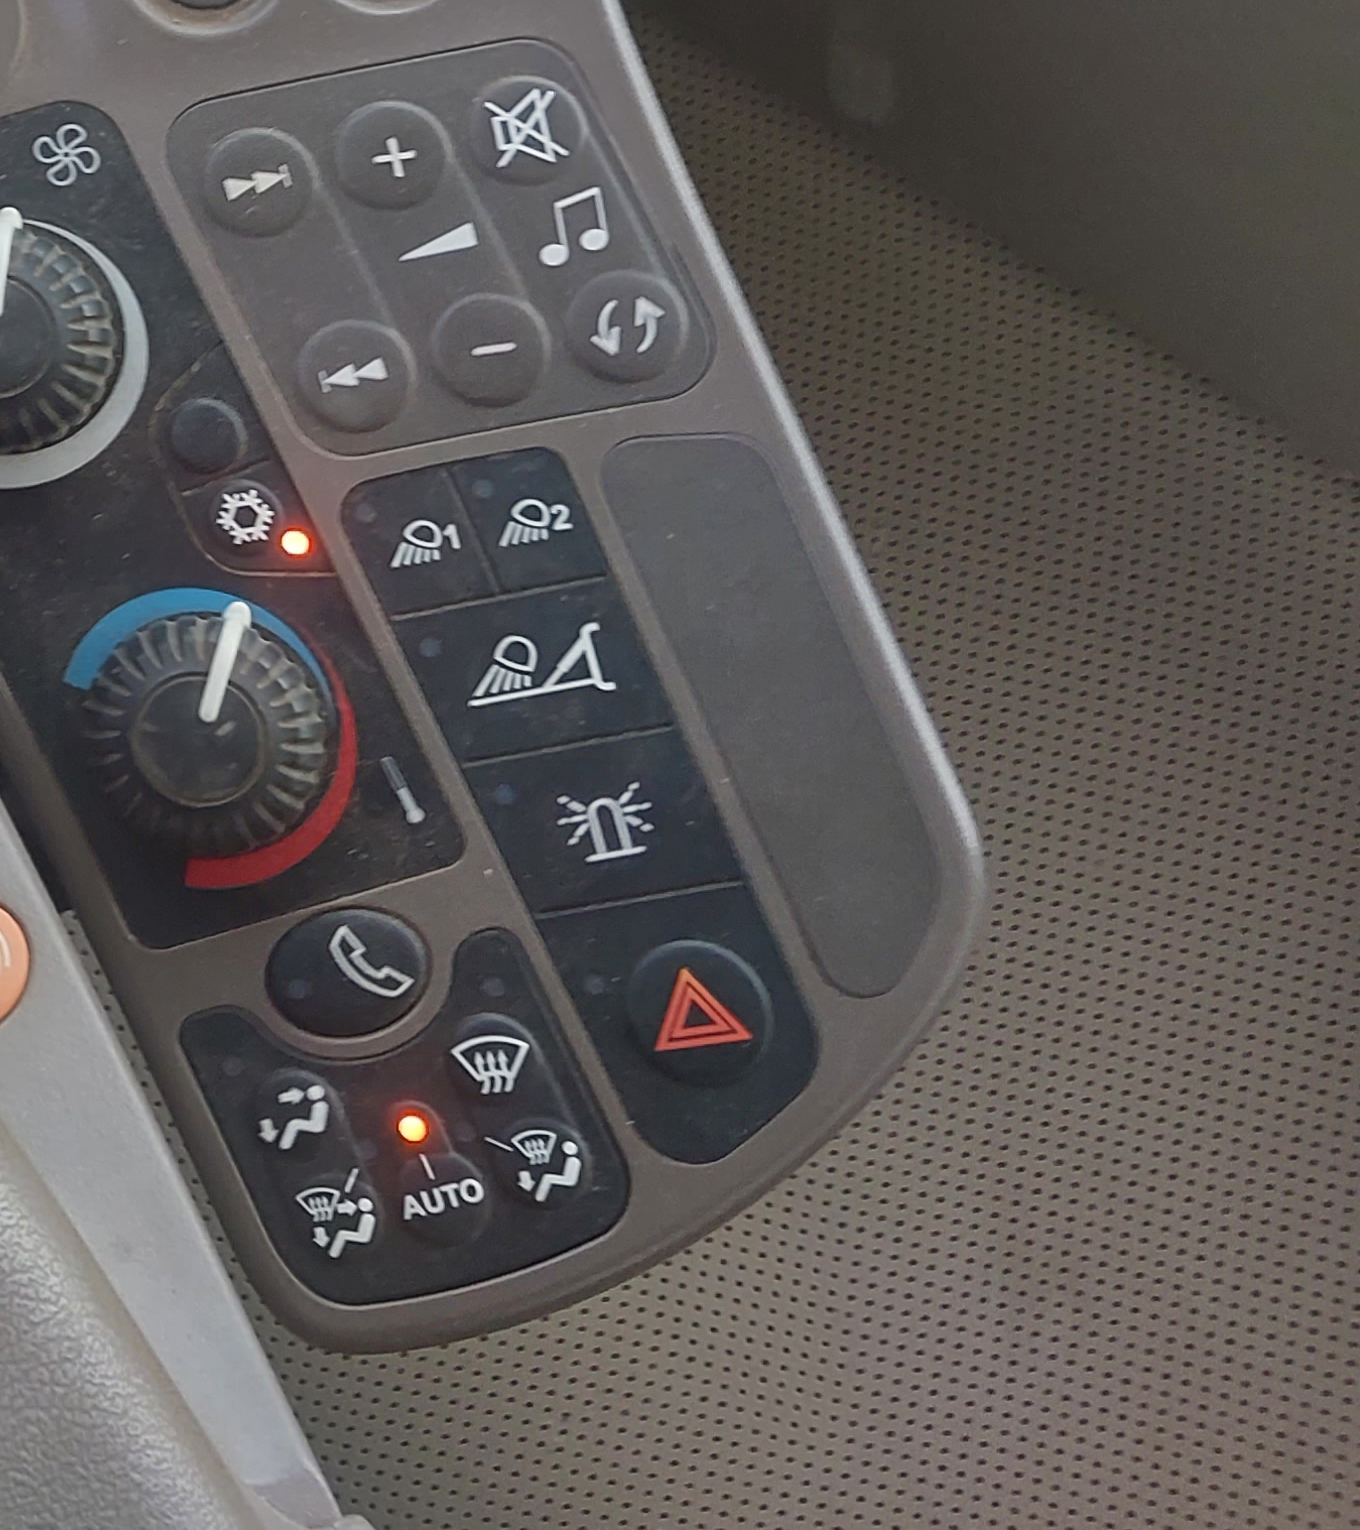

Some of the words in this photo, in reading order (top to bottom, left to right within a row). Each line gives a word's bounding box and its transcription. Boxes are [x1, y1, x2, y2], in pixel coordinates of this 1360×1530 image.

[549, 504, 574, 531] 2
[441, 523, 462, 550] 1
[402, 1178, 485, 1220] AUTO
